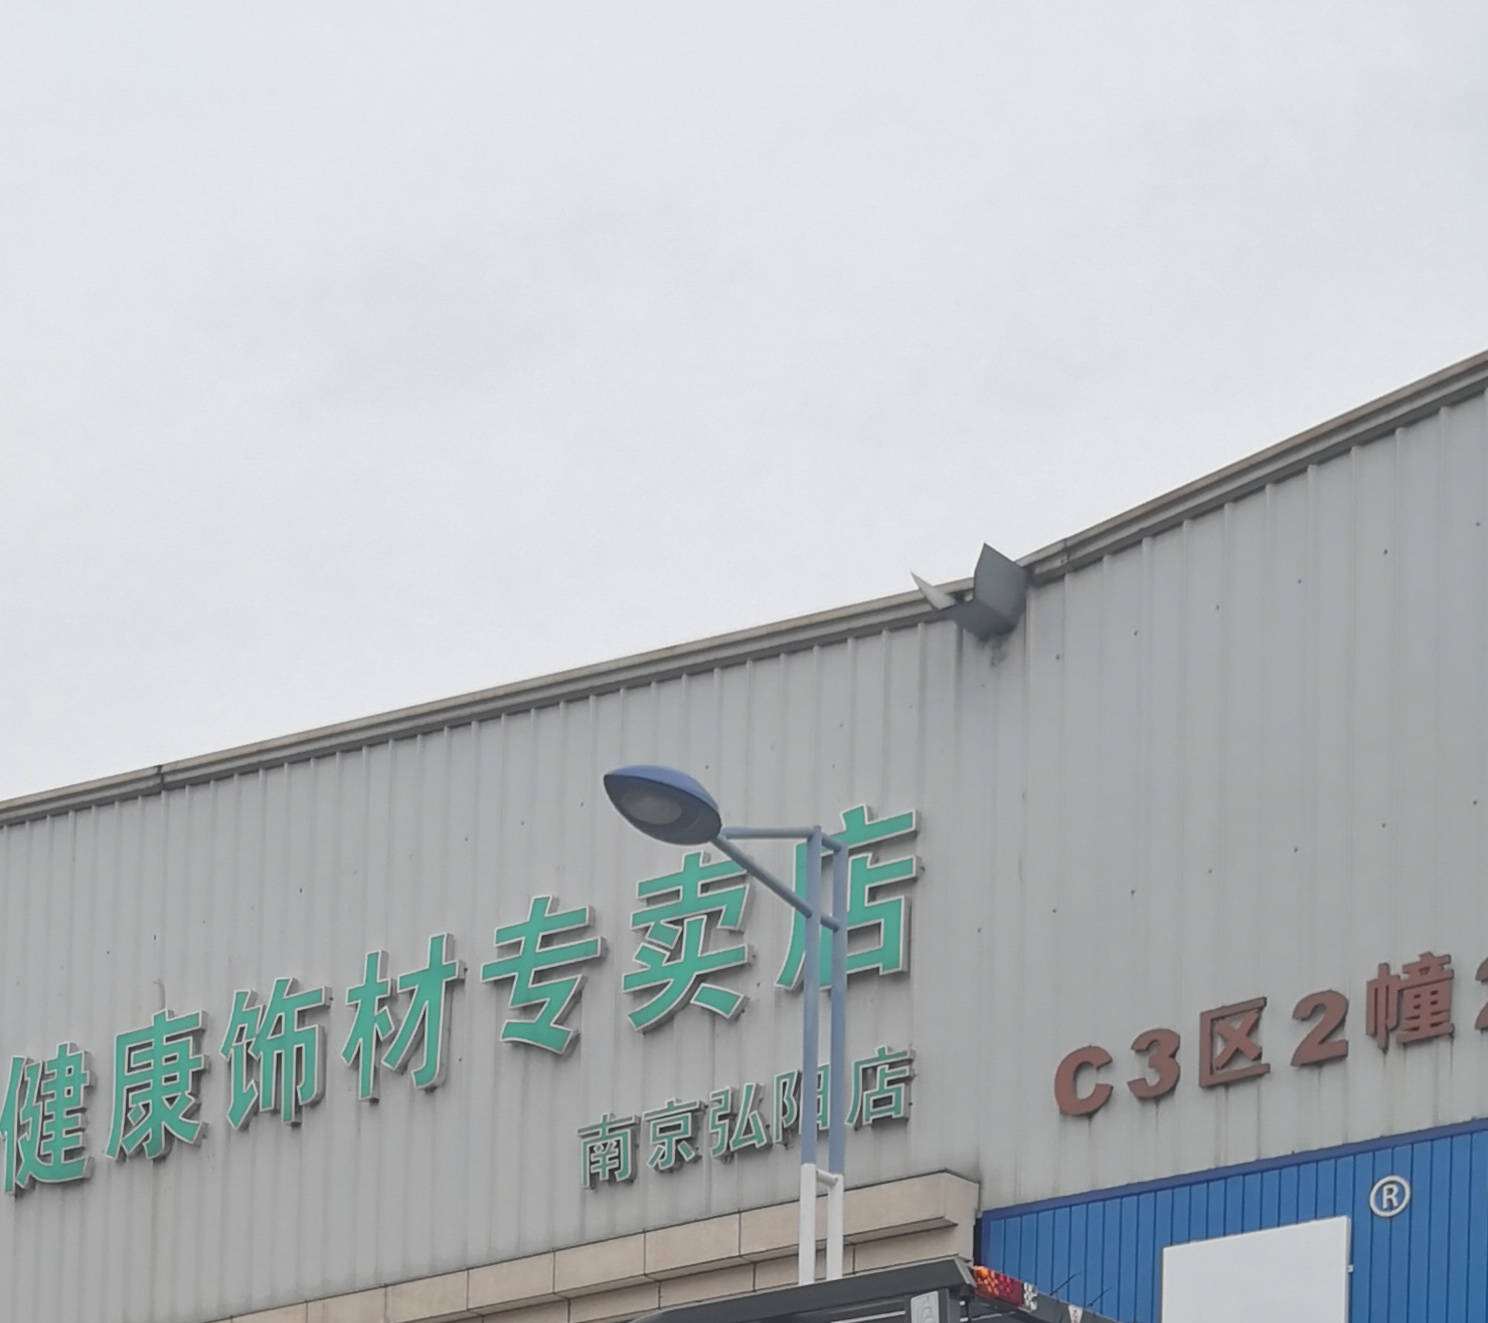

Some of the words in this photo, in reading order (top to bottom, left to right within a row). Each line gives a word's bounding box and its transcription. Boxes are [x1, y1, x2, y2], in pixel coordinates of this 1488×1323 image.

[1054, 951, 1488, 1117] C3区2幢
[577, 1045, 915, 1190] 南京弘阳店
